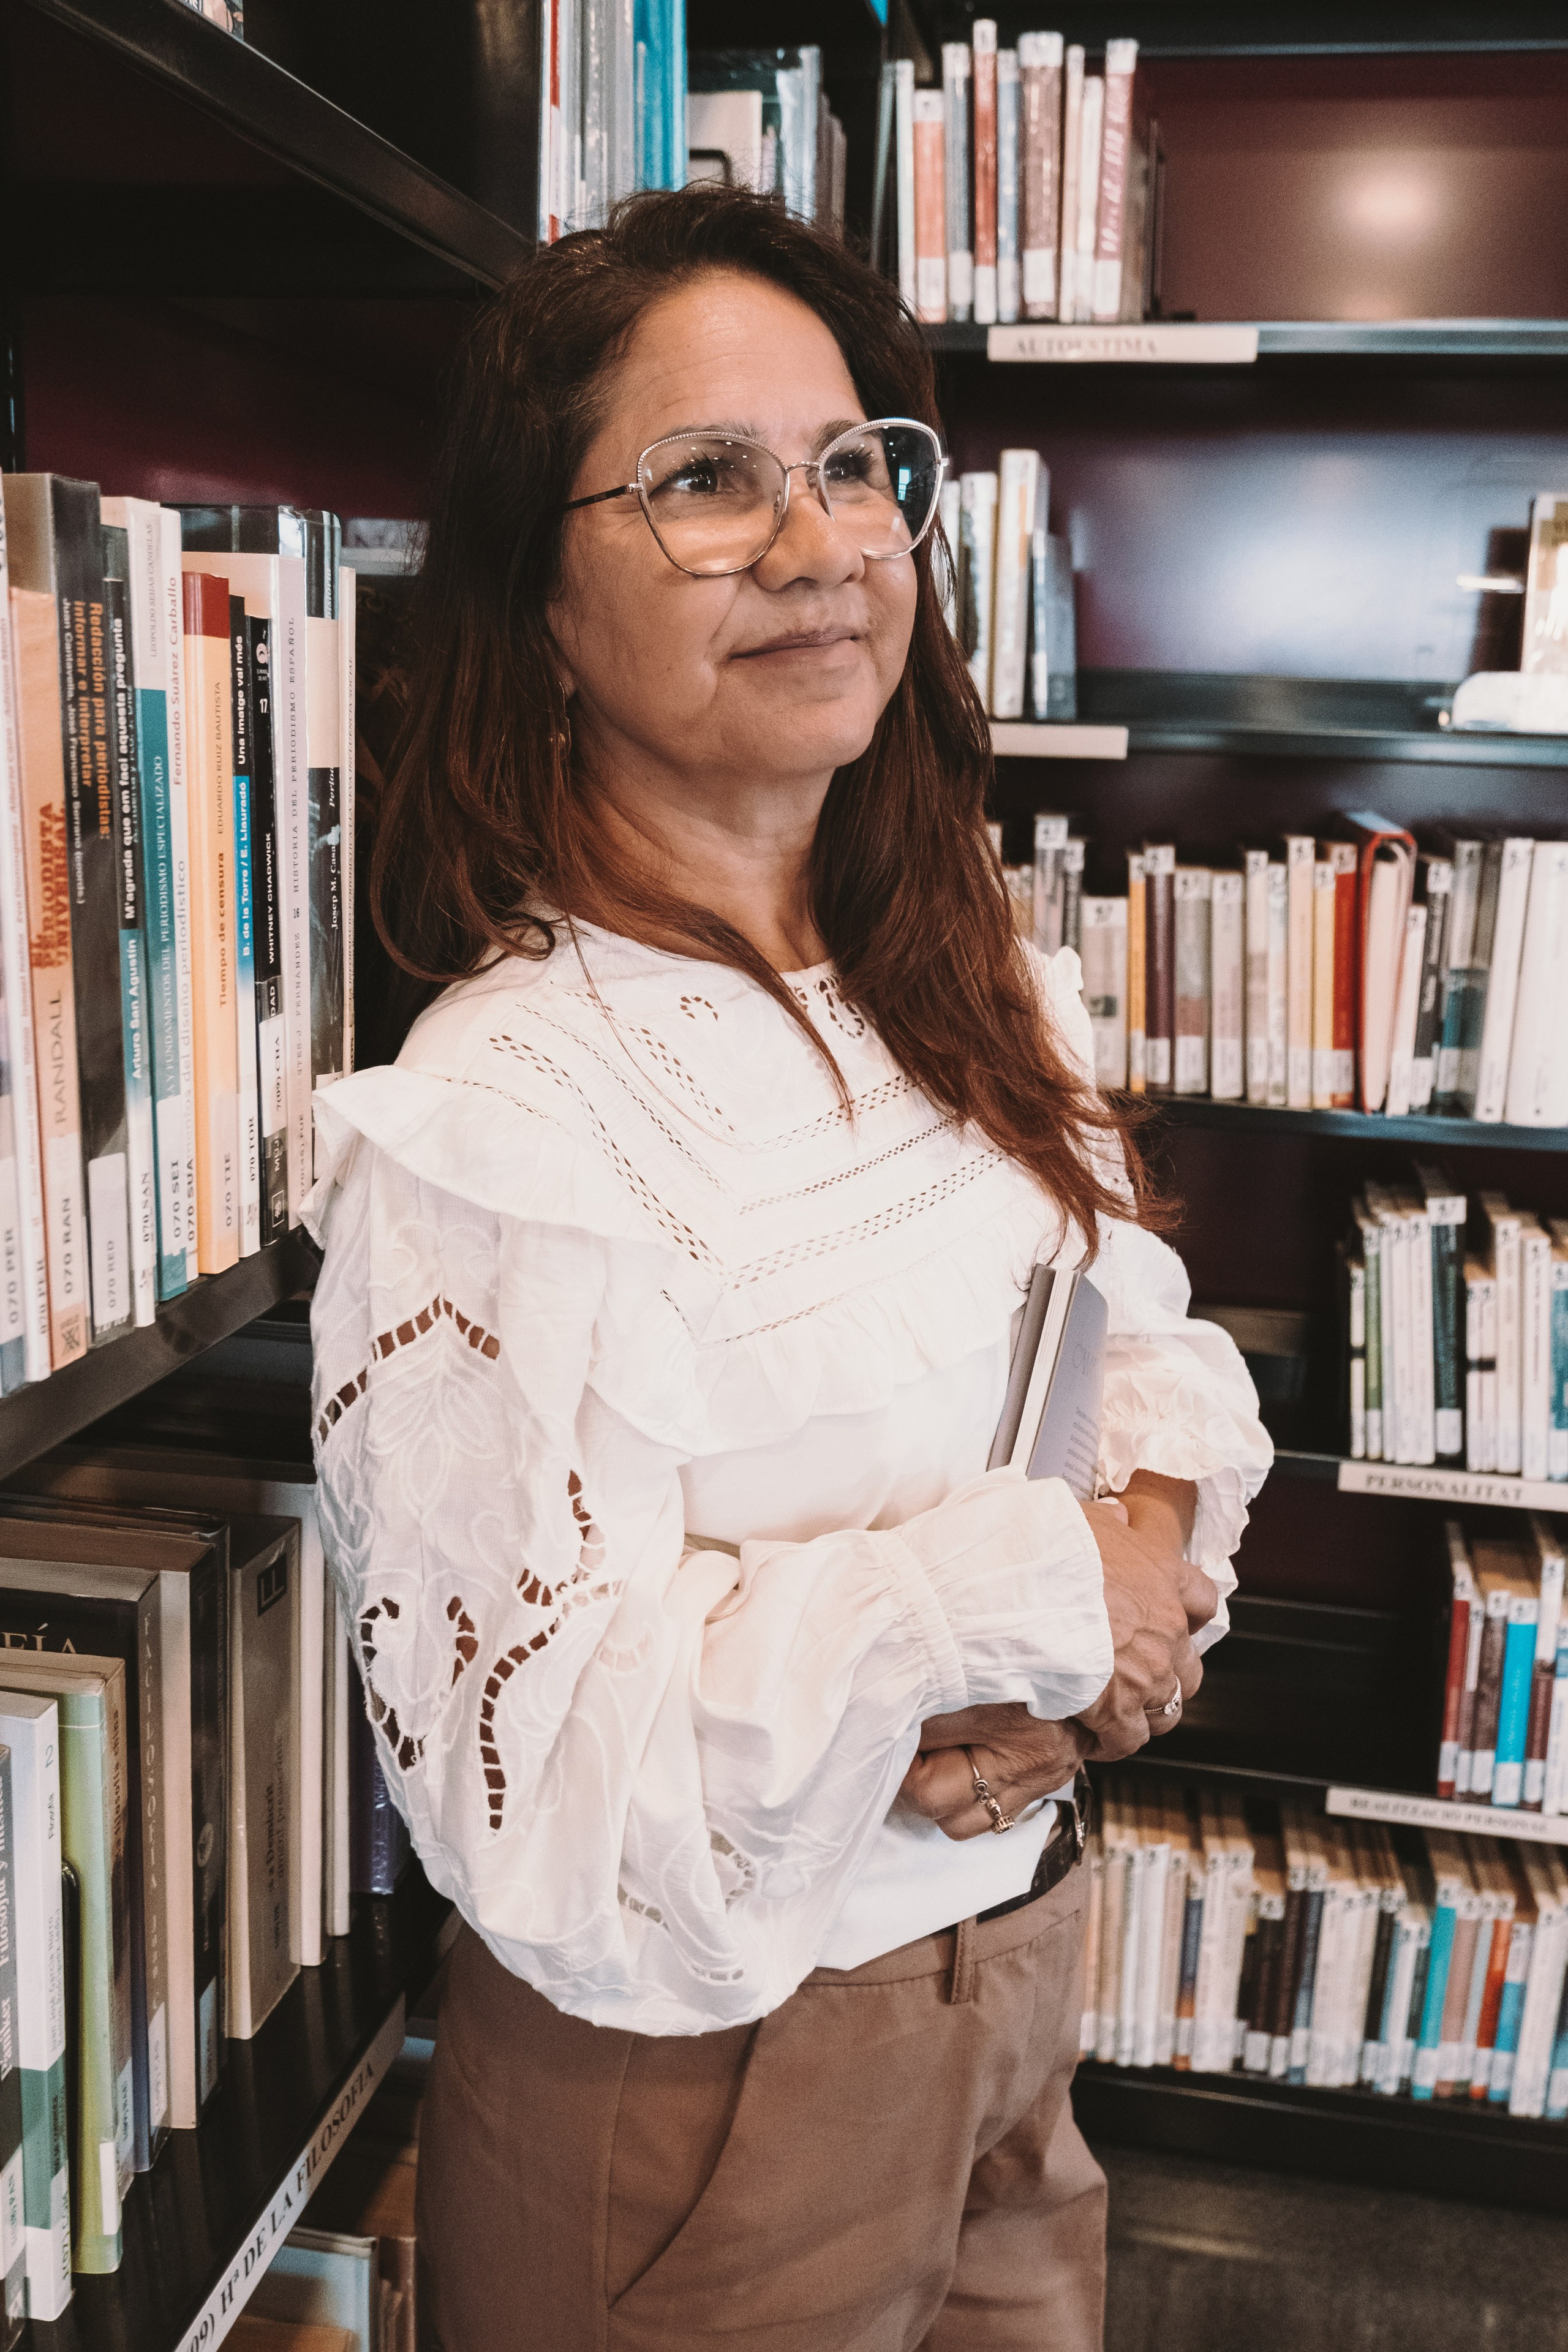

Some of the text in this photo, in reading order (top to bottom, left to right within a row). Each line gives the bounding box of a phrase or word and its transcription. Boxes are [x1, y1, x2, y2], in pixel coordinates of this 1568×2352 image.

[113, 618, 127, 689] pregunta
[168, 577, 181, 786] Fernando Suárez Carballo
[74, 600, 92, 787] informar e interpretar
[89, 602, 111, 840] Redacción para periodistas:
[116, 692, 129, 754] aquesta
[259, 698, 268, 714] 17
[118, 758, 129, 786] faci
[121, 790, 130, 813] em
[123, 816, 134, 846] que
[154, 756, 166, 859] ESPECIALIZADO
[238, 782, 248, 841] Llauradó
[240, 844, 248, 858] E.
[123, 849, 136, 919] M'agrada
[157, 862, 170, 942] PERIODISMO
[242, 906, 249, 919] la
[331, 876, 337, 891] M.
[161, 945, 170, 970] DEL
[218, 922, 225, 943] de
[242, 922, 250, 939] de
[243, 942, 251, 956] B.
[219, 948, 227, 1008] Tiempo
[127, 939, 142, 1079] Arturo San Agustín
[163, 974, 174, 1070] FUNDAMENTOS
[49, 990, 67, 1123] RANDALL
[181, 1055, 191, 1082] del
[141, 1172, 151, 1210] SAN
[171, 1159, 181, 1238] 070 SEI
[62, 1197, 73, 1294] 070 RAN
[107, 1240, 116, 1308] 070 RED
[7, 1281, 19, 1325] 070
[243, 2226, 268, 2280] DE
[271, 2191, 293, 2234] LA
[295, 2060, 375, 2193] FILOSOFIA
